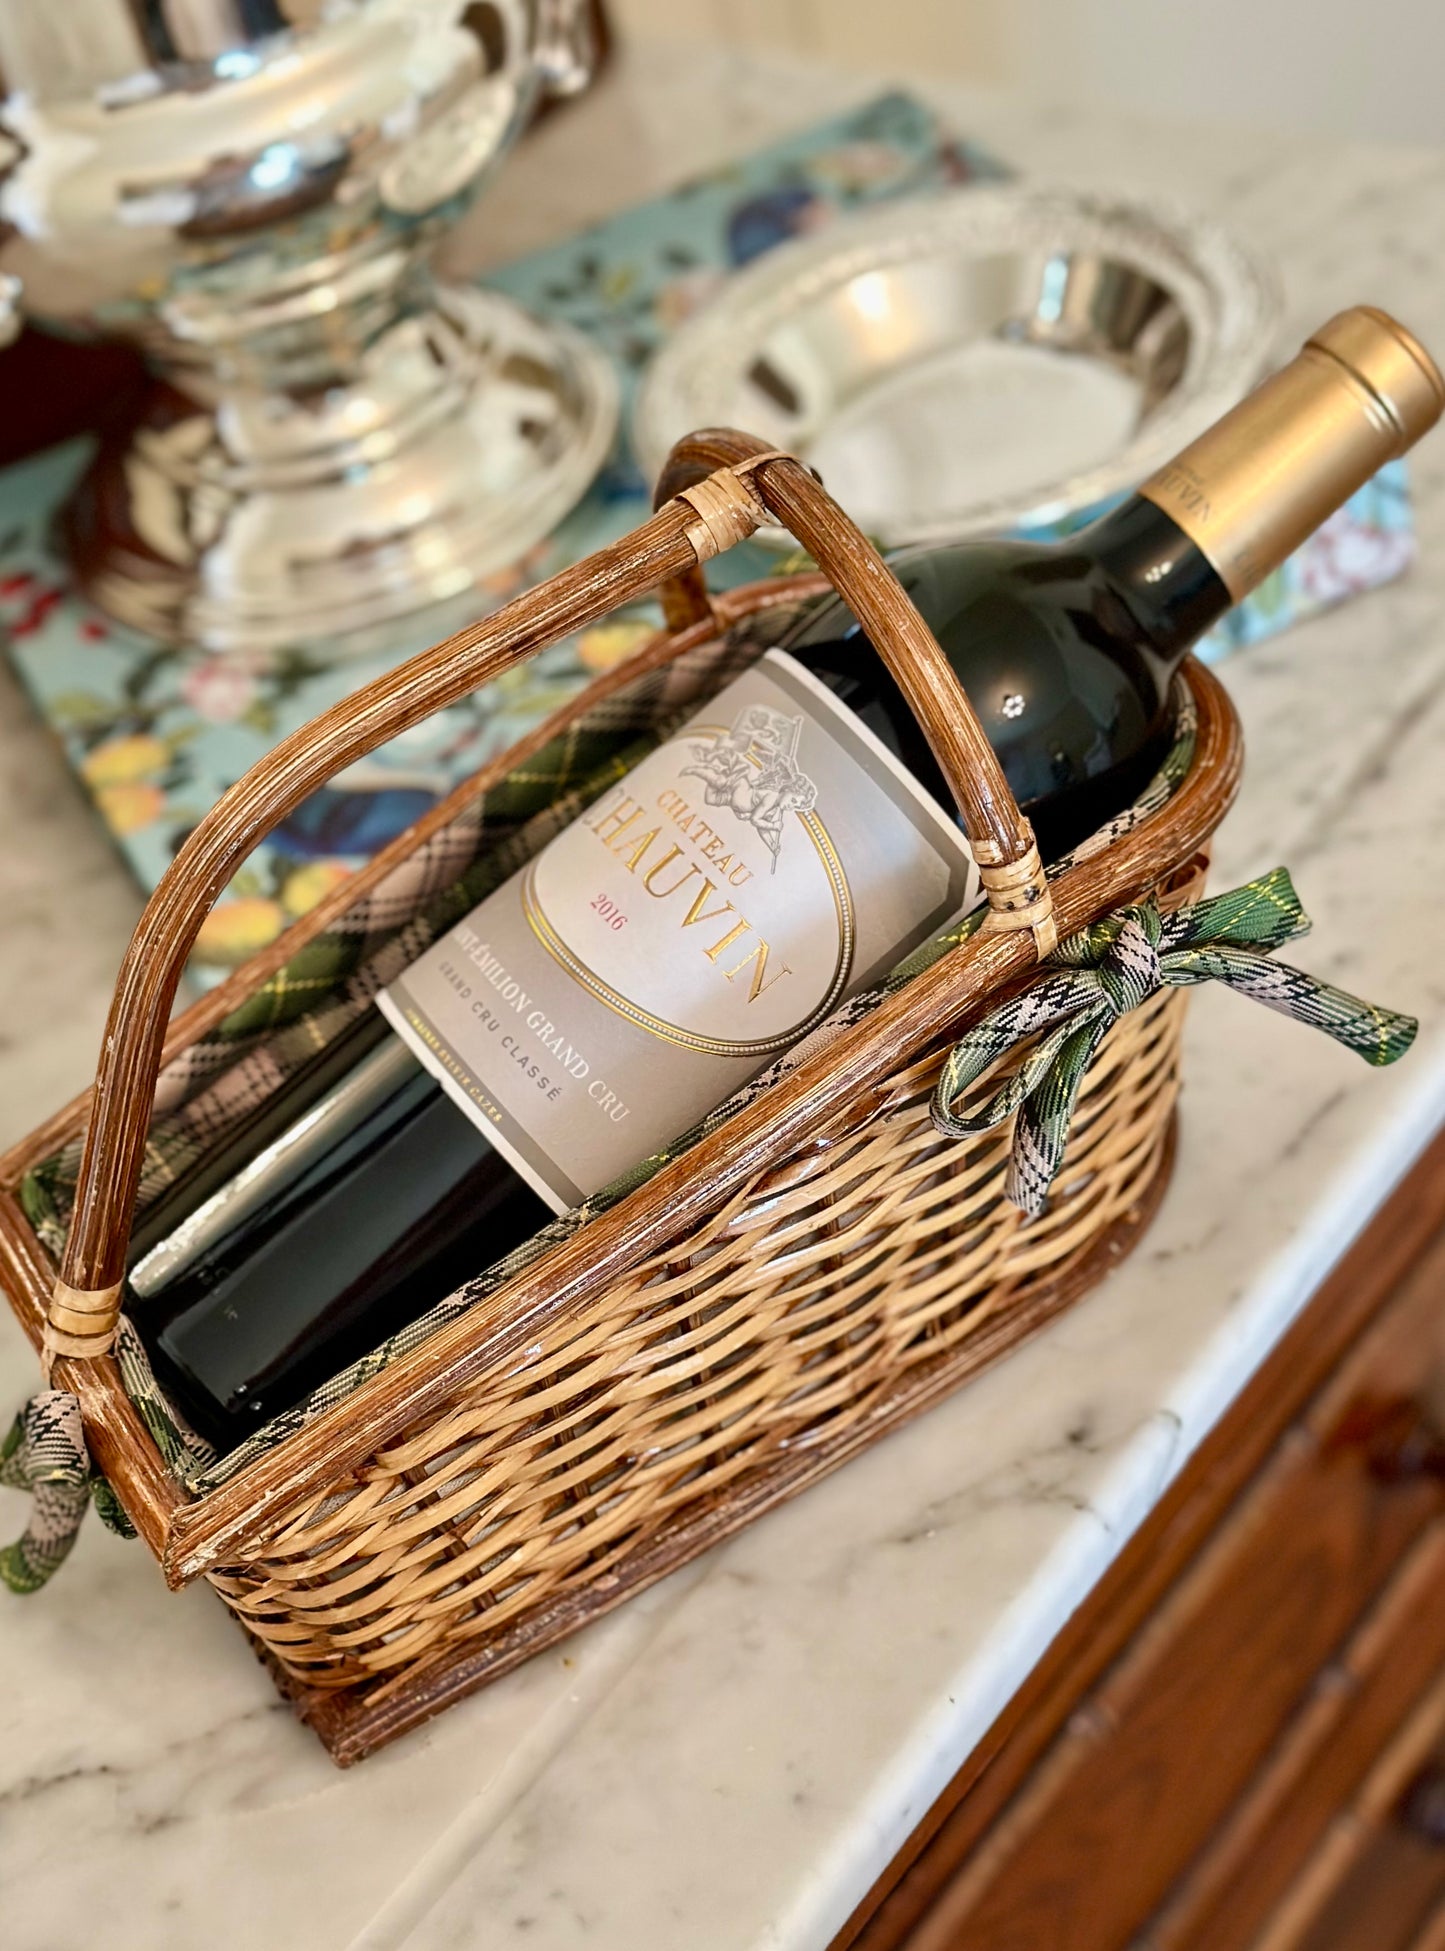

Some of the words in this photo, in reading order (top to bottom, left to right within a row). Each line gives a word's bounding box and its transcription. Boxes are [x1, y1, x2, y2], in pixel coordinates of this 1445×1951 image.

[656, 789, 754, 887] CHATEAU
[590, 893, 628, 932] 2016
[439, 960, 472, 1000] GRAND
[471, 1001, 500, 1032] CRU
[501, 1036, 563, 1101] CLASSÉ
[525, 1010, 590, 1080] GRAND
[587, 1080, 631, 1123] CRU
